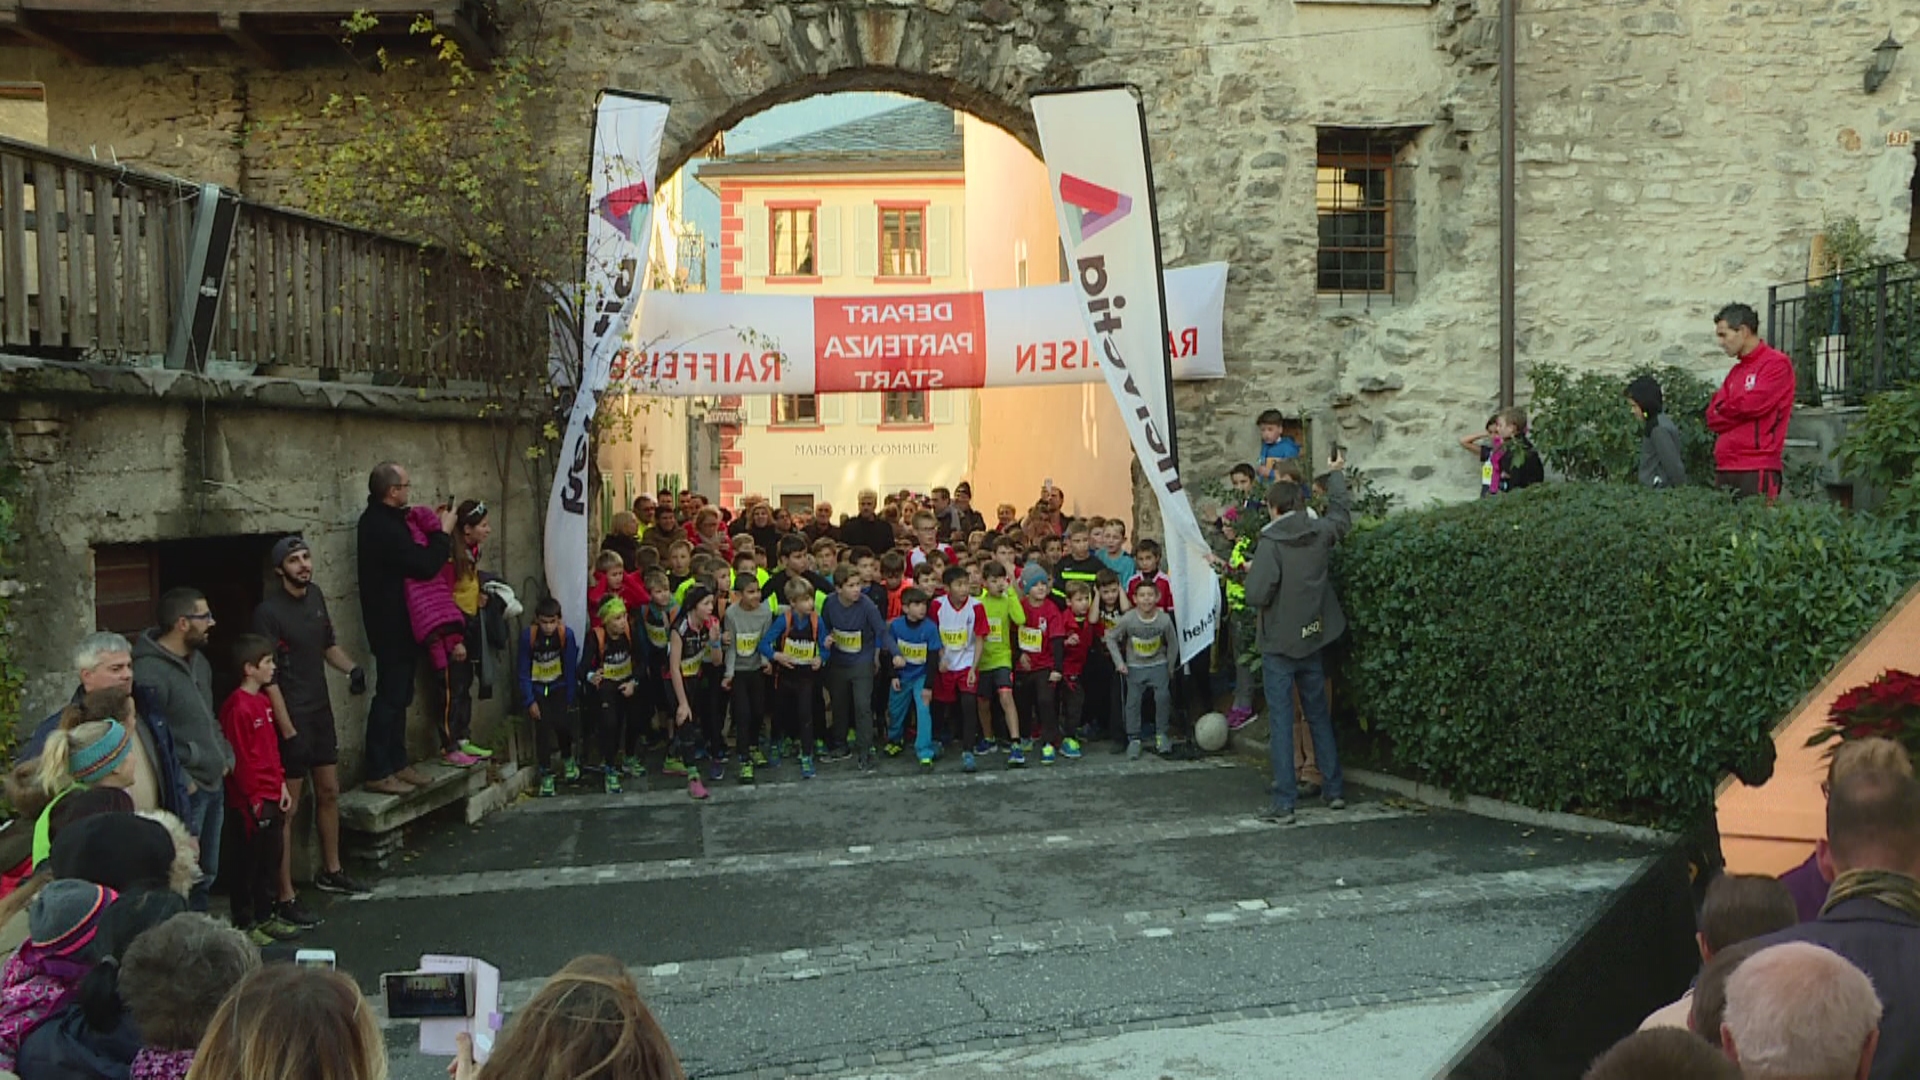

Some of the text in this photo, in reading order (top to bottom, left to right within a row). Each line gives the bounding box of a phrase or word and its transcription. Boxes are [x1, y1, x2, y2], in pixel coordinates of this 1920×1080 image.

[794, 443, 939, 456] MAISON DE COMMUNE
